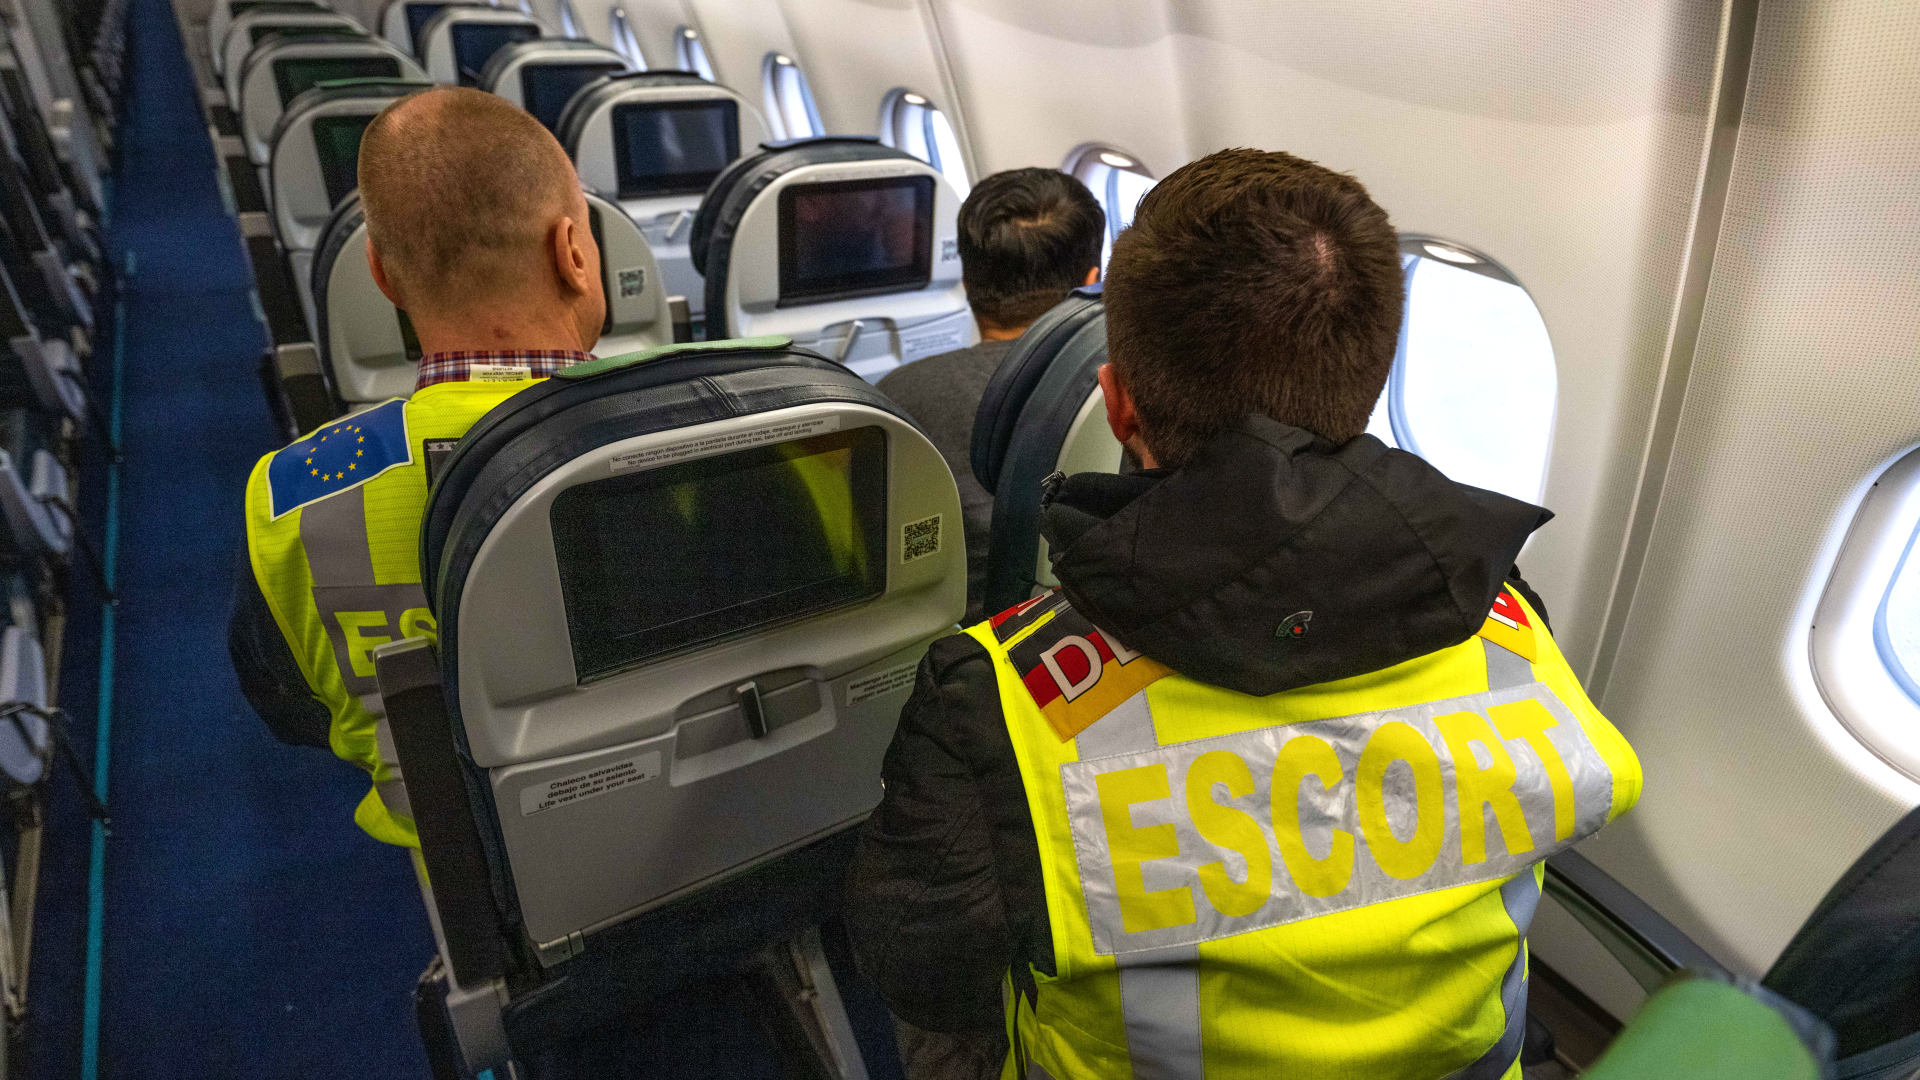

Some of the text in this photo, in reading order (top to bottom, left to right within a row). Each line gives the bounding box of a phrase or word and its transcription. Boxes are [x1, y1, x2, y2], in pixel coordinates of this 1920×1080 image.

[622, 452, 644, 461] conecte
[665, 443, 693, 453] dispositivo
[706, 438, 726, 447] pantalla
[772, 425, 796, 433] despegue
[637, 456, 656, 464] device
[671, 449, 693, 459] plugged
[700, 443, 724, 452] electrical
[538, 773, 645, 809] Life vest under your seat
[547, 786, 578, 799] debajo
[606, 768, 637, 781] asiento
[550, 762, 633, 790] Chaleco salvavidas
[1095, 698, 1576, 934] ESCORT
